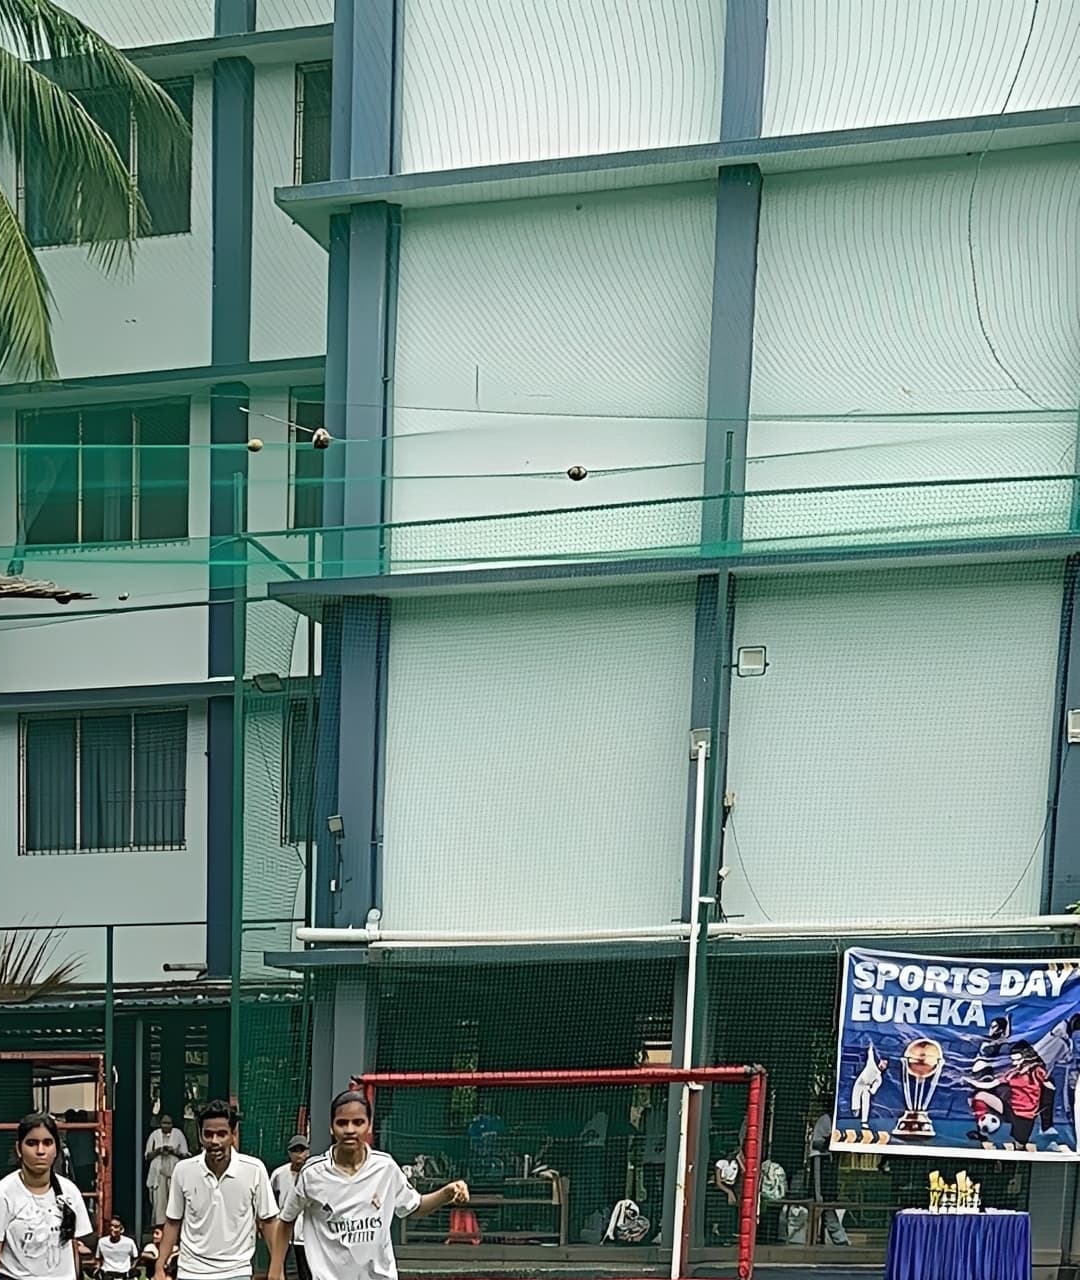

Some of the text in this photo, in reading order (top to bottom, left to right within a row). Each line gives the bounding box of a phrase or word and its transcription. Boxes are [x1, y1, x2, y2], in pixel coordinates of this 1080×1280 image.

[852, 961, 1070, 997] SPORTS DAY
[851, 994, 986, 1027] EUREKA
